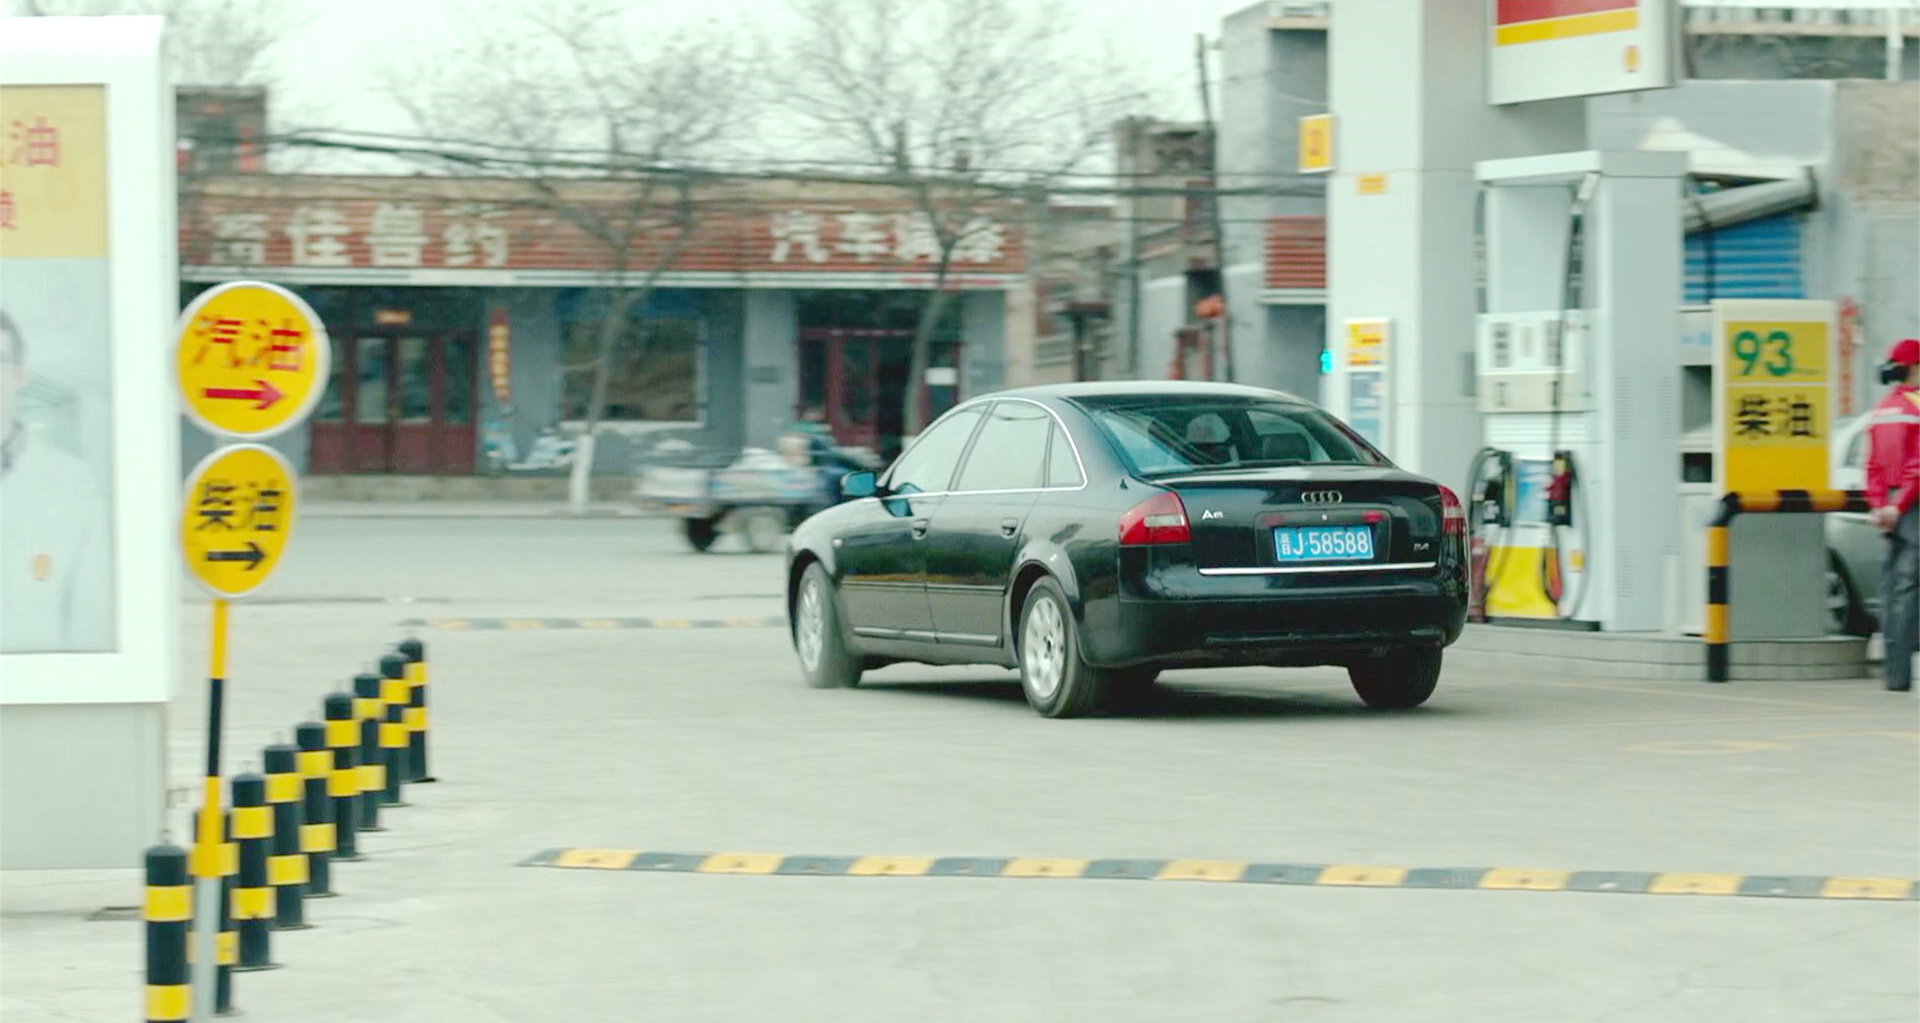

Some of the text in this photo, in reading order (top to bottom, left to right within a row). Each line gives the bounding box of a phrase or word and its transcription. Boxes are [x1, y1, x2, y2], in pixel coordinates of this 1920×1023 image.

[193, 314, 303, 371] 汽油
[1732, 330, 1793, 377] 93
[1734, 390, 1818, 440] 柴油
[196, 480, 283, 532] 柴油
[1202, 509, 1223, 520] A6
